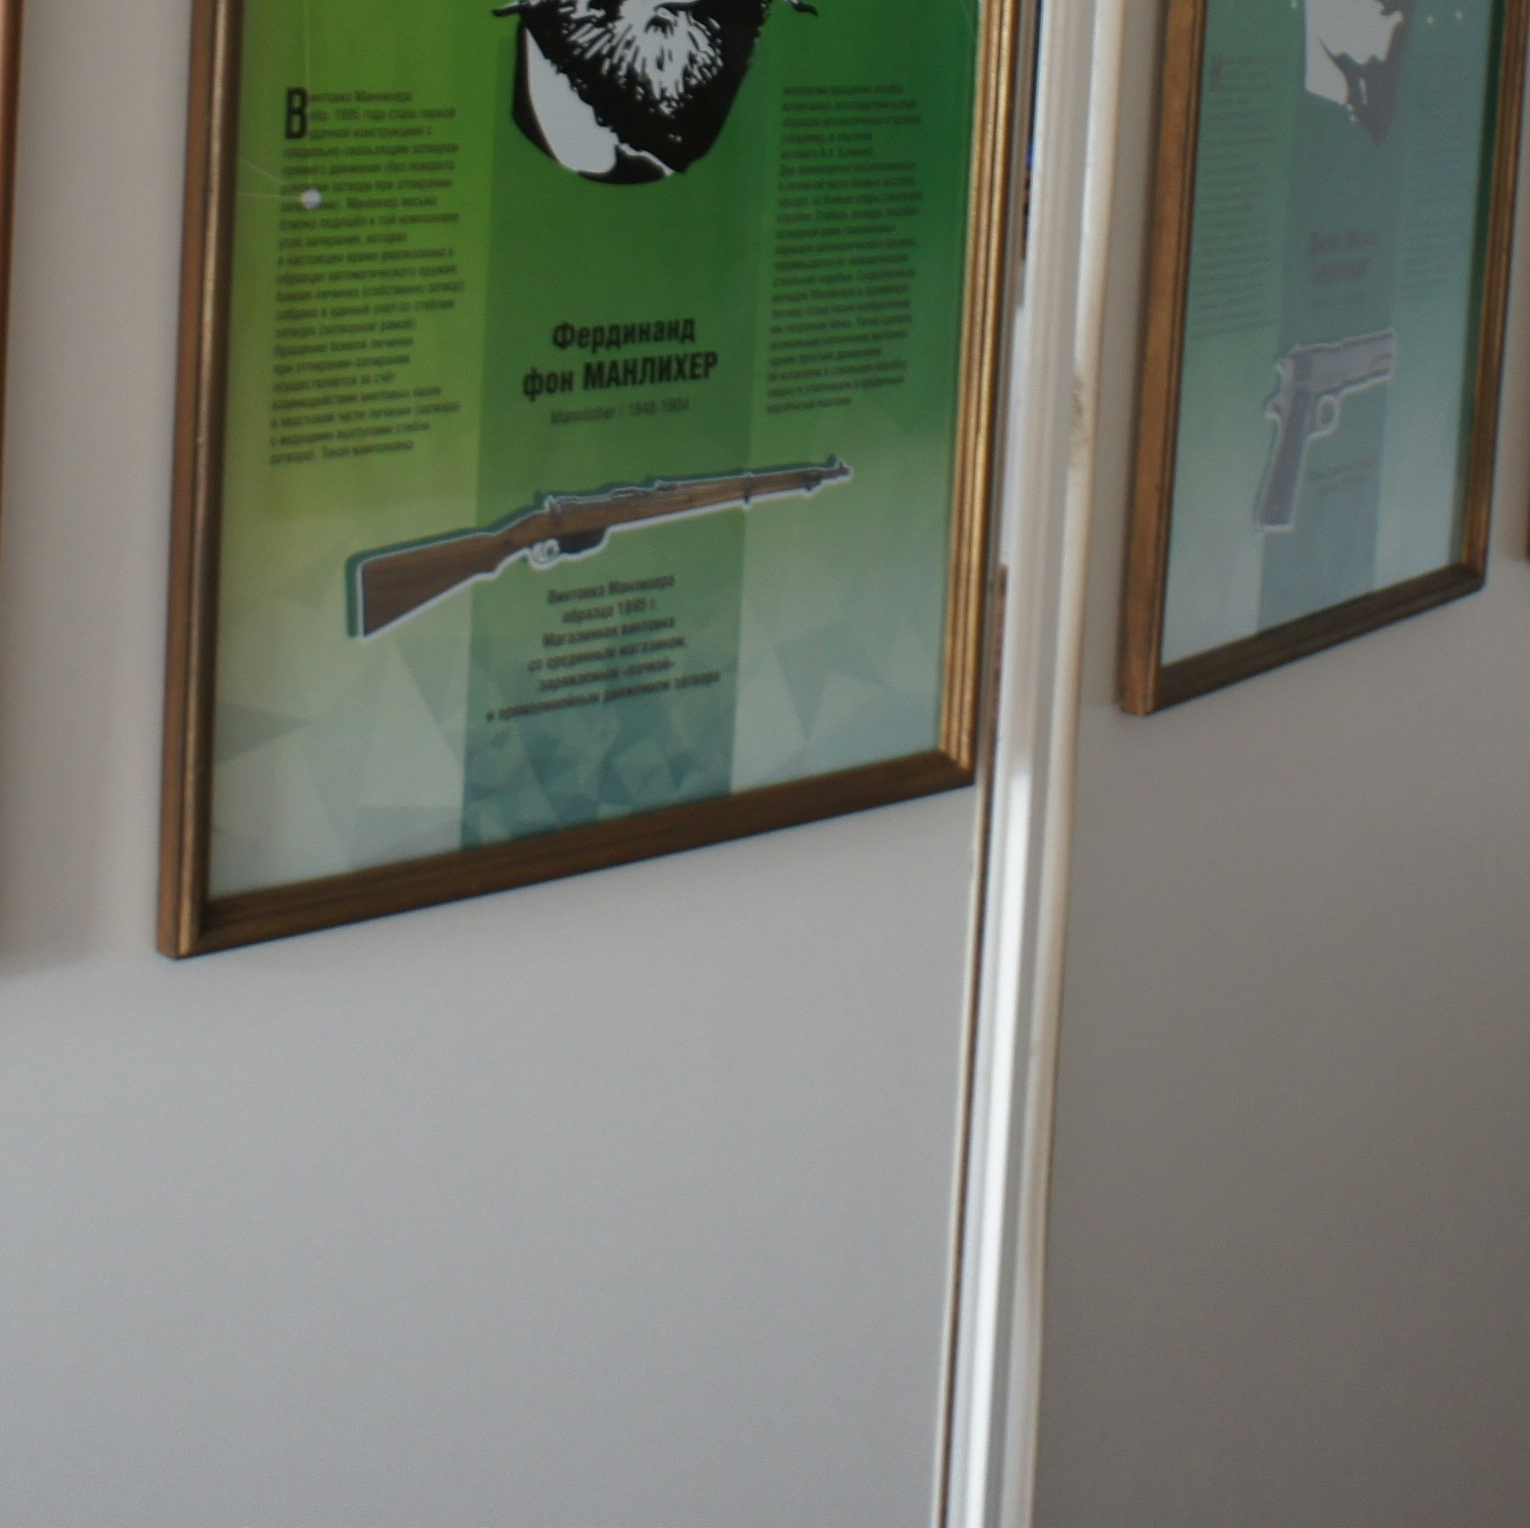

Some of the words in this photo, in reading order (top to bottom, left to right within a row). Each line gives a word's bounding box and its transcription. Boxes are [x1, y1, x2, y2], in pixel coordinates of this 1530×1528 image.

[553, 318, 696, 353] Фердинанд
[522, 368, 573, 401] фон
[583, 351, 719, 390] МАНЛИХЕР
